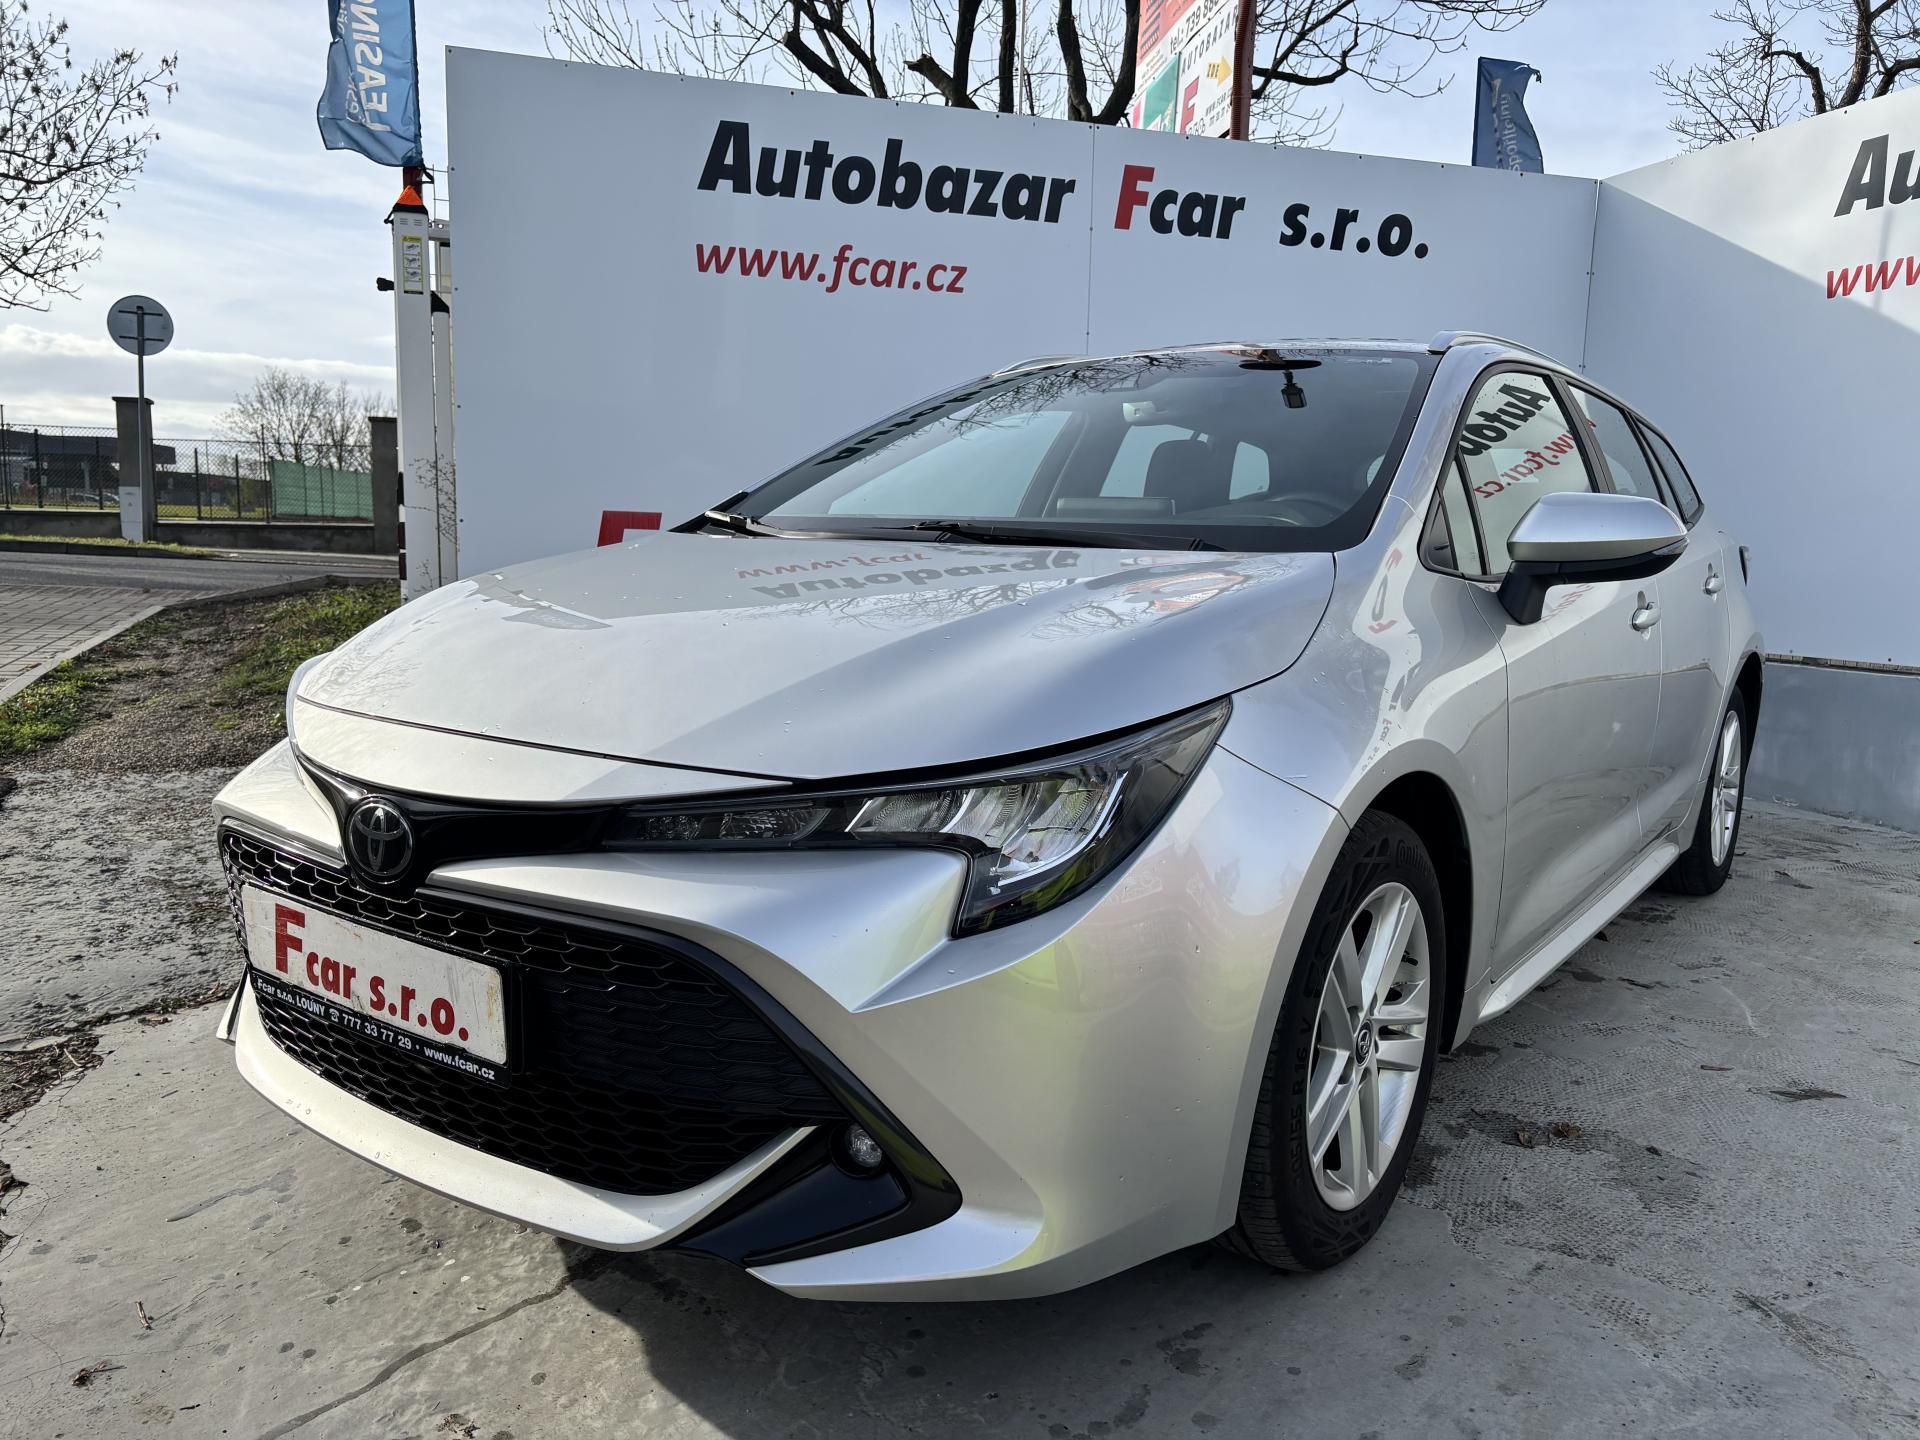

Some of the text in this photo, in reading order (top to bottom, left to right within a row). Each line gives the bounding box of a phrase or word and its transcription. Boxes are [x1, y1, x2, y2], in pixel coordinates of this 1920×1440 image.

[697, 120, 1429, 259] Autobazar Fcar s.r.o.
[696, 243, 968, 293] www.fcar.cz
[257, 979, 275, 996] Fcar
[296, 994, 326, 1017] LOUNY
[342, 1013, 361, 1031] 777
[364, 1021, 378, 1038] 33
[380, 1028, 394, 1043] 77
[398, 1035, 412, 1050] 29
[424, 1046, 495, 1081] www.fcar.cz
[275, 902, 469, 1041] Fcar s.r.o.
